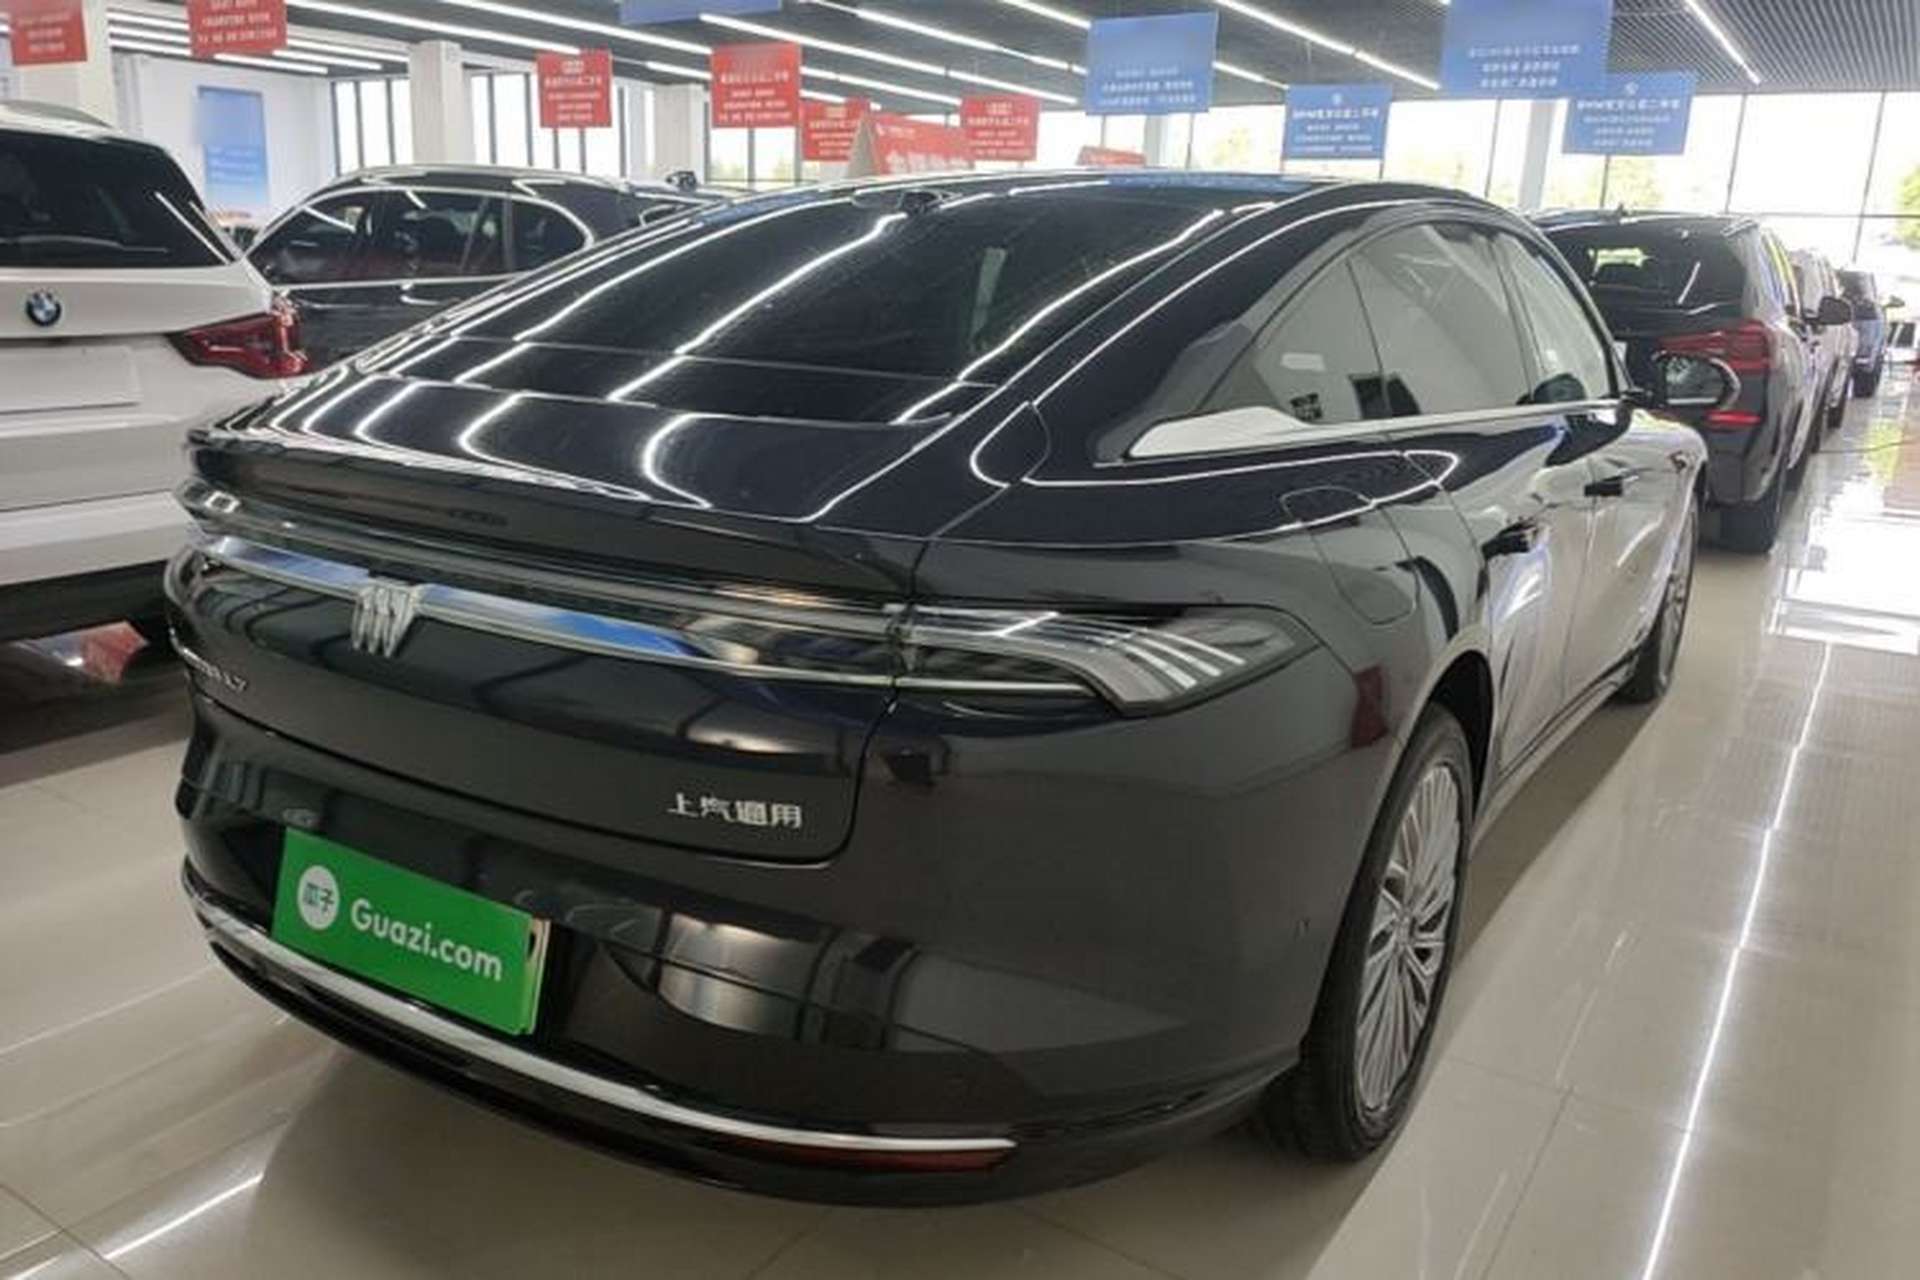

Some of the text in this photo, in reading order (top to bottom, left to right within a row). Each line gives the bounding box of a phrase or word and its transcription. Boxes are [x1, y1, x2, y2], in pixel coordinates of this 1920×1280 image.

[667, 792, 802, 829] 上汽通用
[350, 898, 502, 982] Guazi.com
